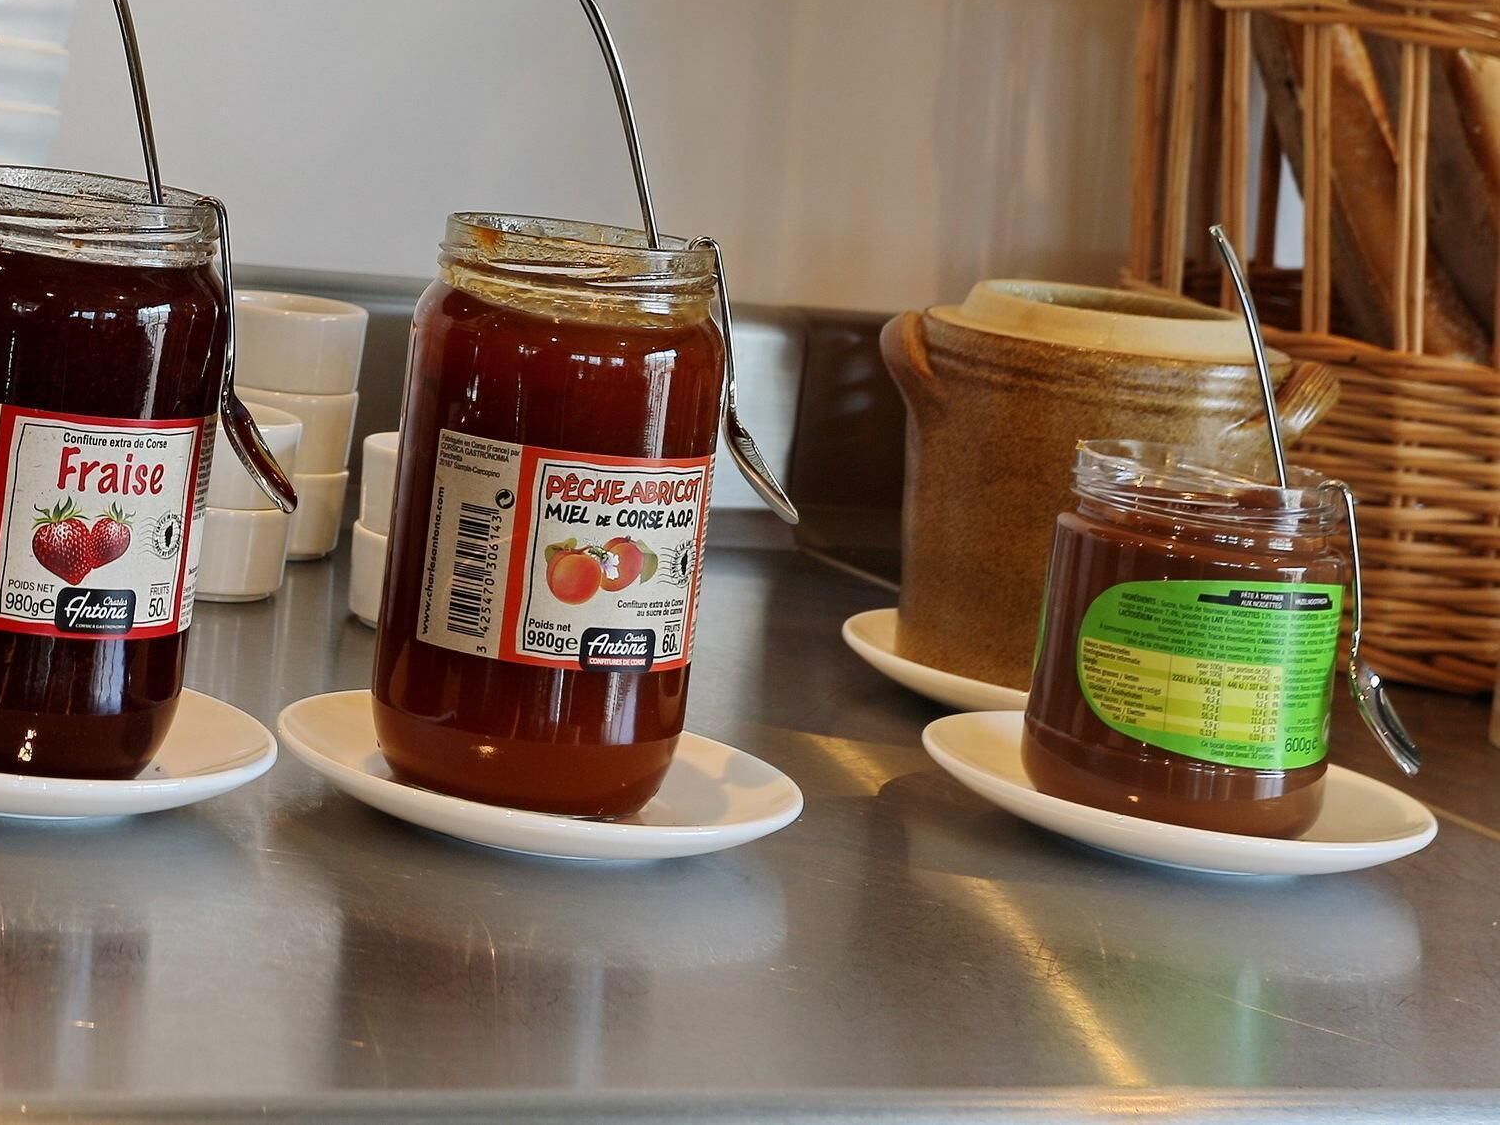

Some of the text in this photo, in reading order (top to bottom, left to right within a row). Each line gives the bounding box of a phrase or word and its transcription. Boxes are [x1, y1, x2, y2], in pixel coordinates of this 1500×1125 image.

[63, 432, 168, 449] Confiture extra de Corse
[441, 442, 510, 463] CORSICA GASTRONOMIA
[471, 441, 486, 450] Corse
[487, 444, 510, 456] (France)
[511, 449, 521, 457] par
[57, 446, 165, 496] Fraise
[545, 503, 590, 525] MIEL
[616, 509, 665, 530] CORSE
[485, 515, 503, 570] 306143
[422, 486, 445, 635] www.charlesantona.com
[7, 578, 55, 593] POIDS NET
[149, 586, 170, 596] FRUITS
[103, 596, 128, 606] Charles
[479, 578, 495, 634] 425470
[617, 598, 684, 608] Confiture extra de Corse
[64, 591, 128, 628] Antona
[646, 609, 662, 617] sucre
[663, 608, 669, 616] de
[669, 608, 683, 616] canne
[528, 618, 571, 632] Poids net
[664, 623, 681, 633] FRUITS
[587, 633, 649, 657] Antona
[624, 632, 648, 643] Charles
[476, 645, 487, 653] 3
